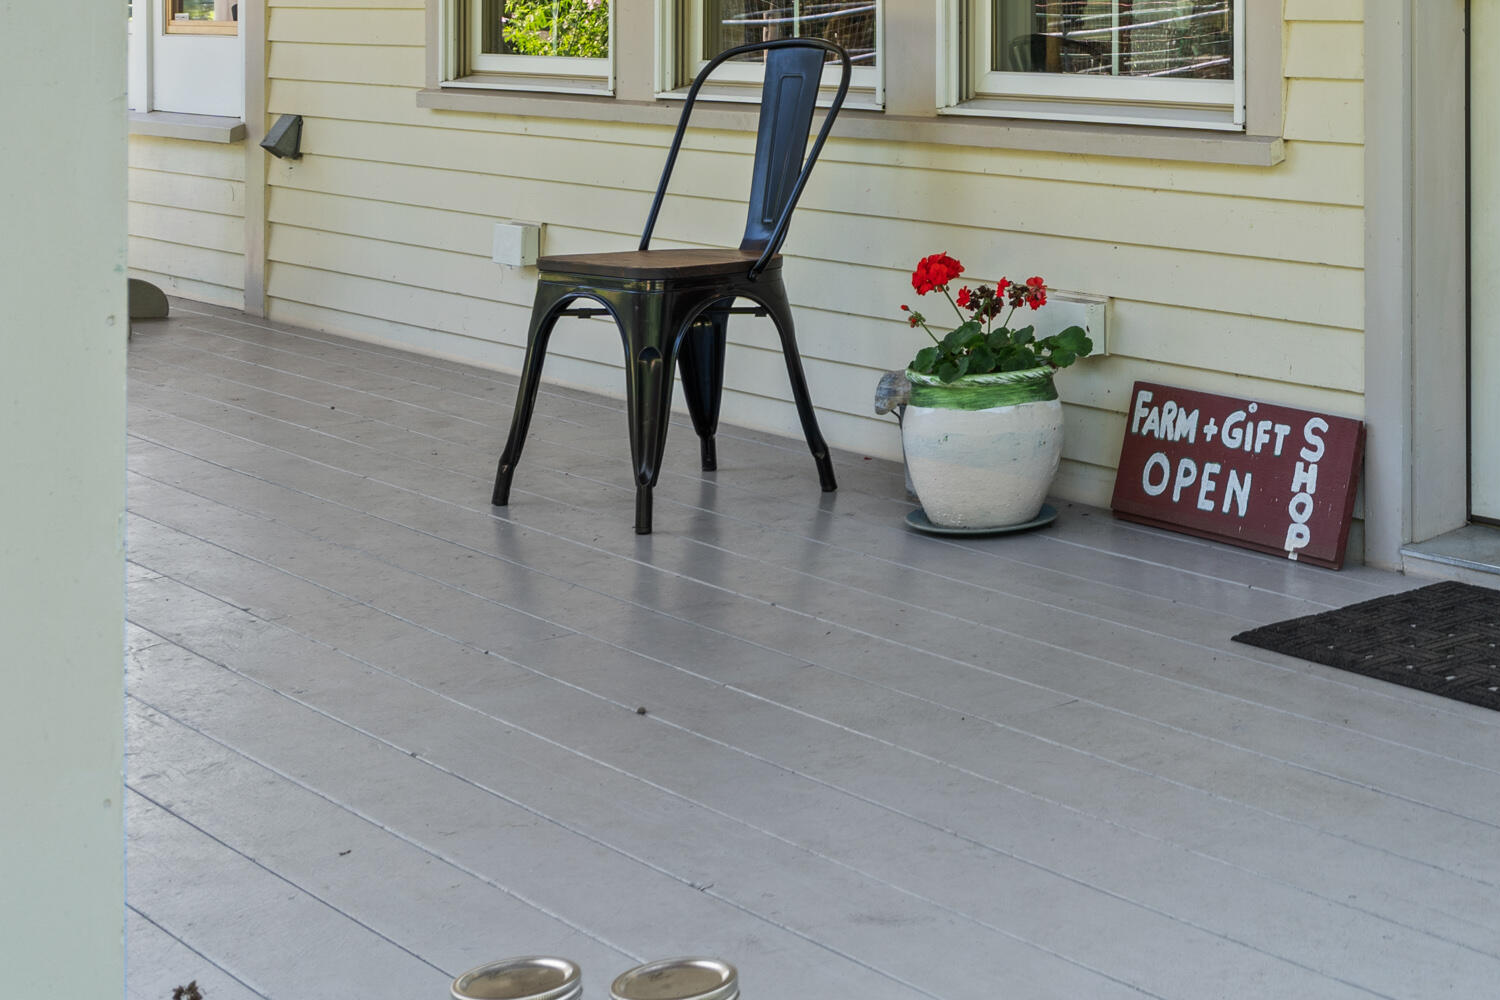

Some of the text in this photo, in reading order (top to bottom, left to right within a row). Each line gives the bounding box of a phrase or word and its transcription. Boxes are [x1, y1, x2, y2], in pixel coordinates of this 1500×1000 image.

[1131, 390, 1200, 444] FARM
[1141, 452, 1252, 517] OPEN
[1284, 416, 1329, 560] SHOP
